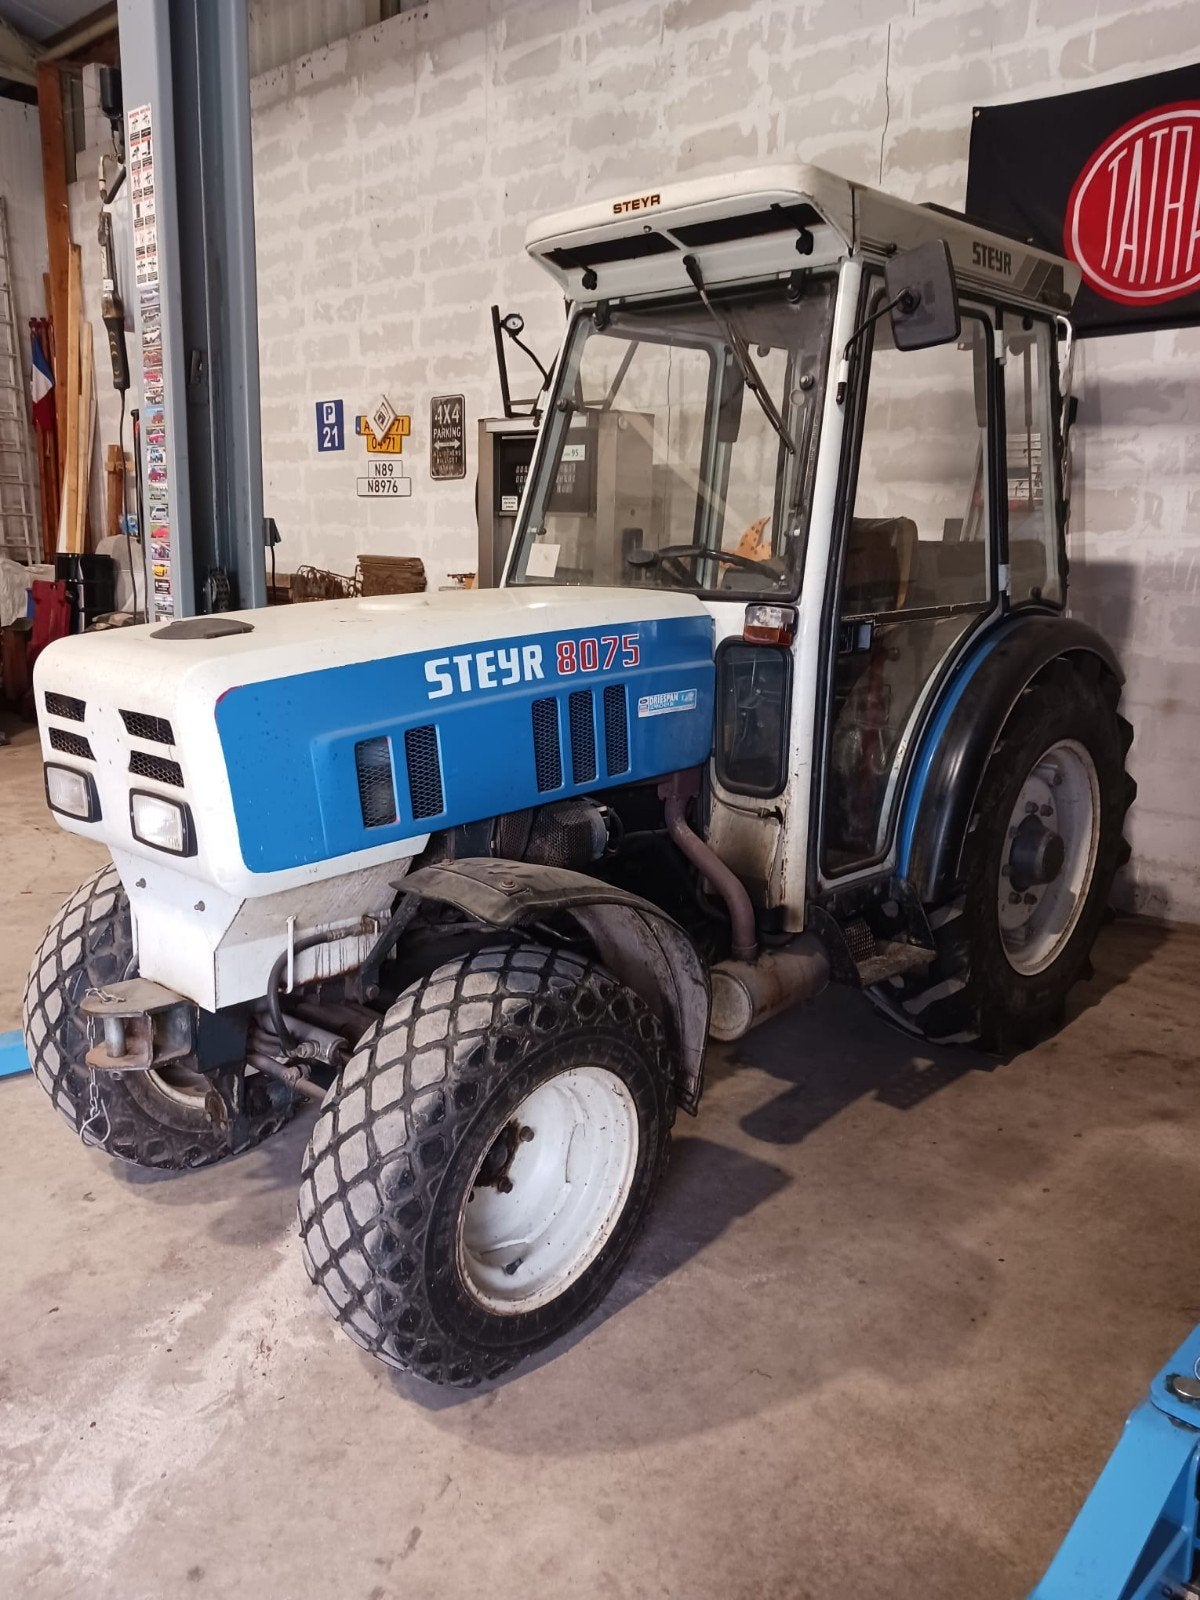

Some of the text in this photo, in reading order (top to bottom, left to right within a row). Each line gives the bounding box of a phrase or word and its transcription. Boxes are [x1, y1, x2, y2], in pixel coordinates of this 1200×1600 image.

[613, 194, 661, 214] STEYR
[972, 241, 1012, 275] STEYR
[325, 405, 334, 421] P
[435, 403, 460, 424] 4X4
[323, 426, 339, 448] 21
[433, 426, 461, 438] PARKING
[374, 463, 394, 477] N89
[367, 479, 398, 493] N8976
[424, 633, 641, 700] STEYR 8075
